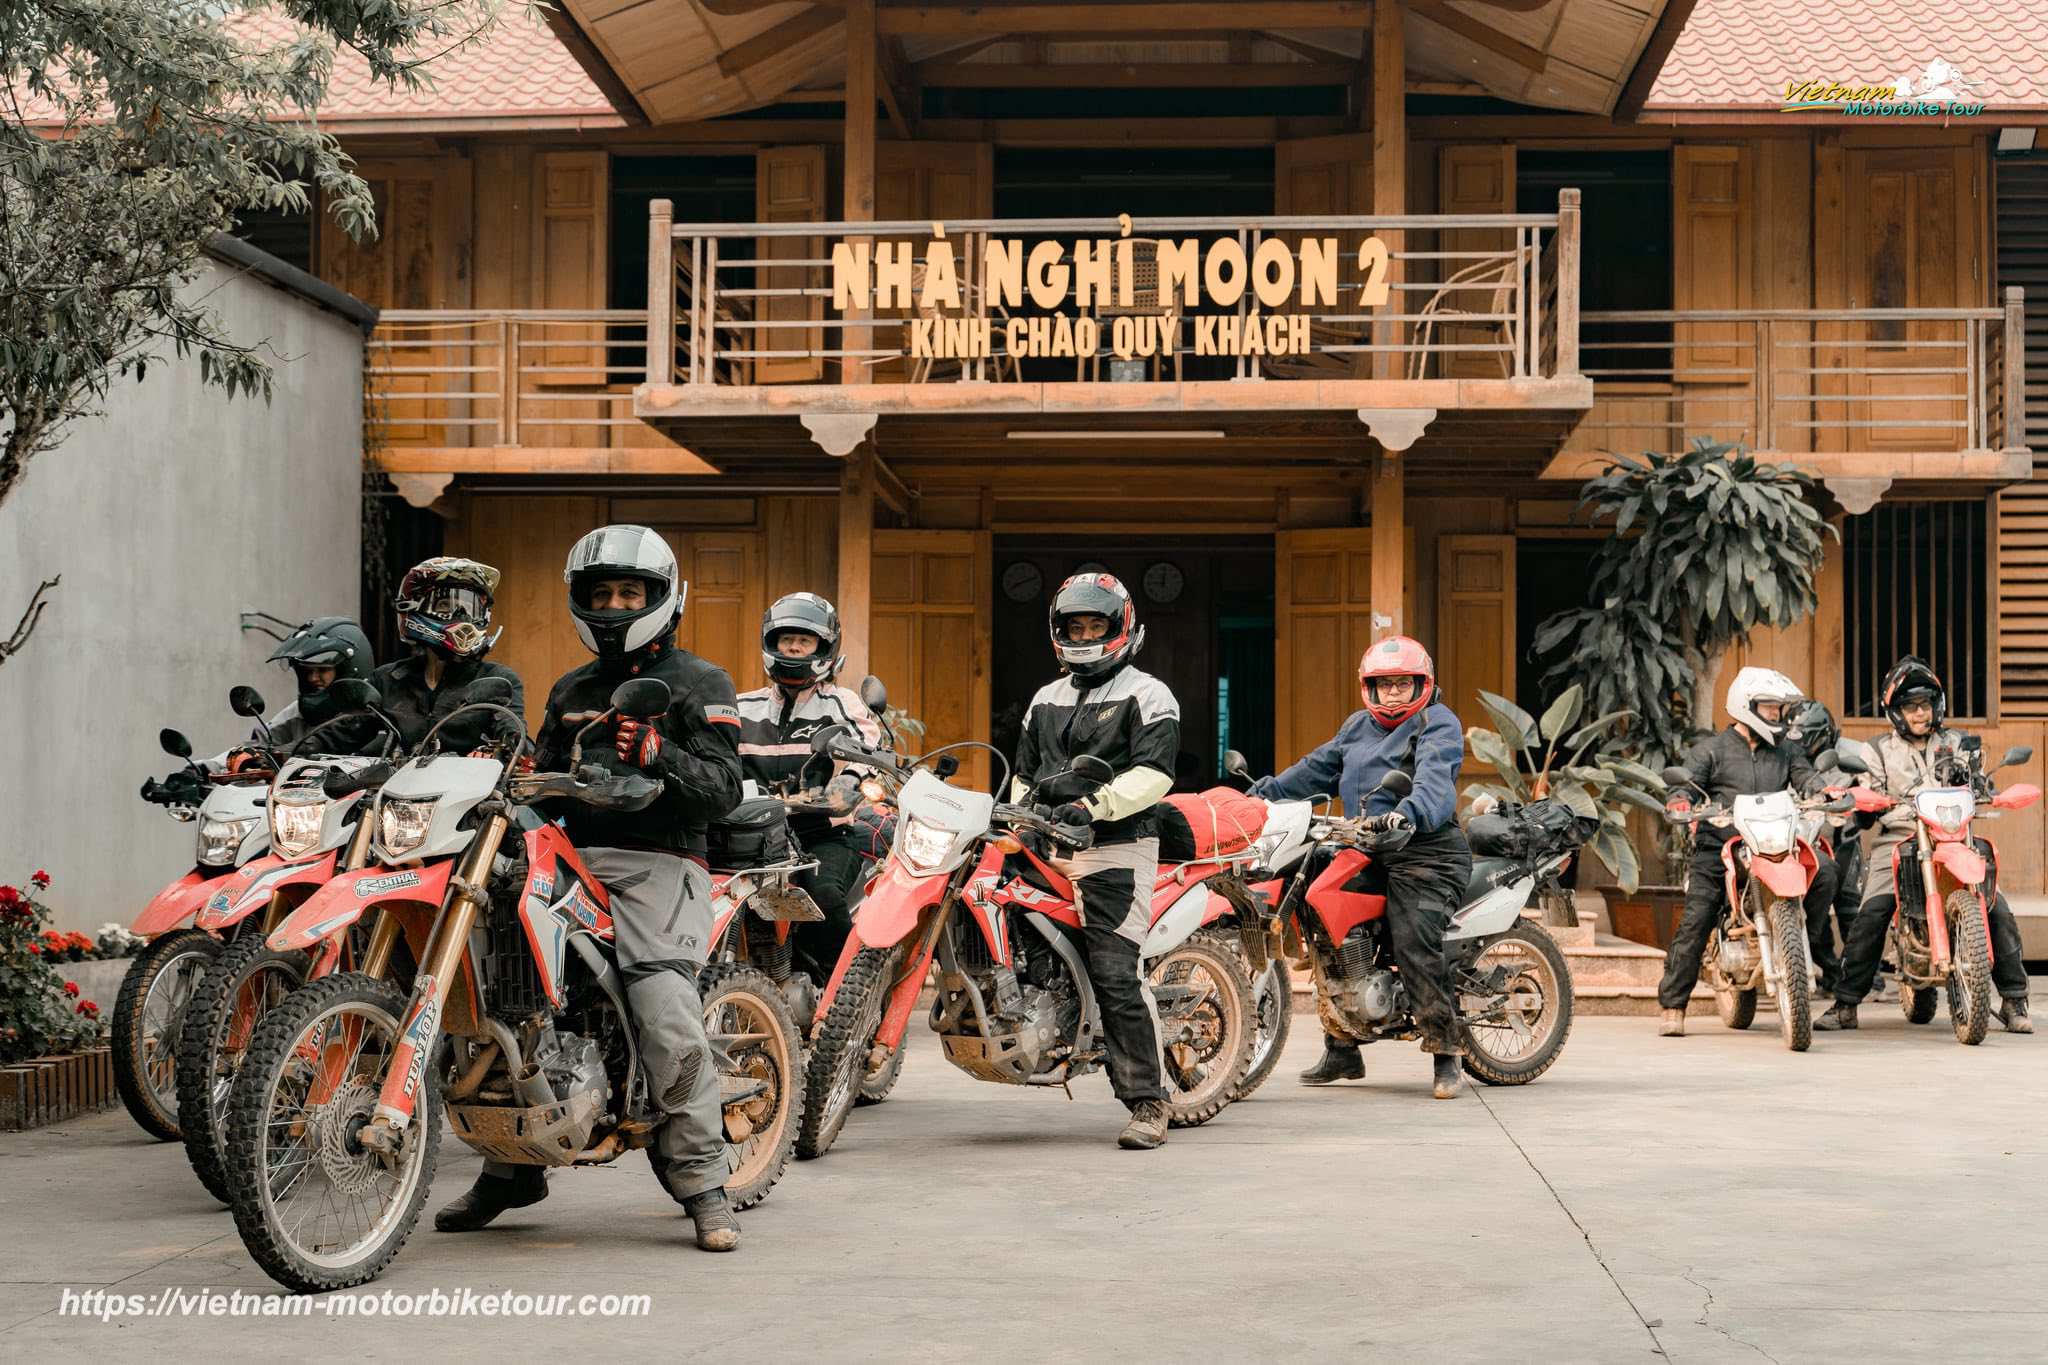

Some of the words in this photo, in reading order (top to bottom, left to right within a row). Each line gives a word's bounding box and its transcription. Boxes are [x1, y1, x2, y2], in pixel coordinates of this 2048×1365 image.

[831, 221, 961, 310] NHÀ
[984, 213, 1134, 309] NGHỈ
[1156, 237, 1338, 307] MOON
[1358, 236, 1390, 306] 2
[1006, 311, 1097, 358] CHÀO
[1112, 309, 1178, 361] QUÝ
[1195, 308, 1311, 356] KHÁCH
[402, 1000, 437, 1099] DUNLOP
